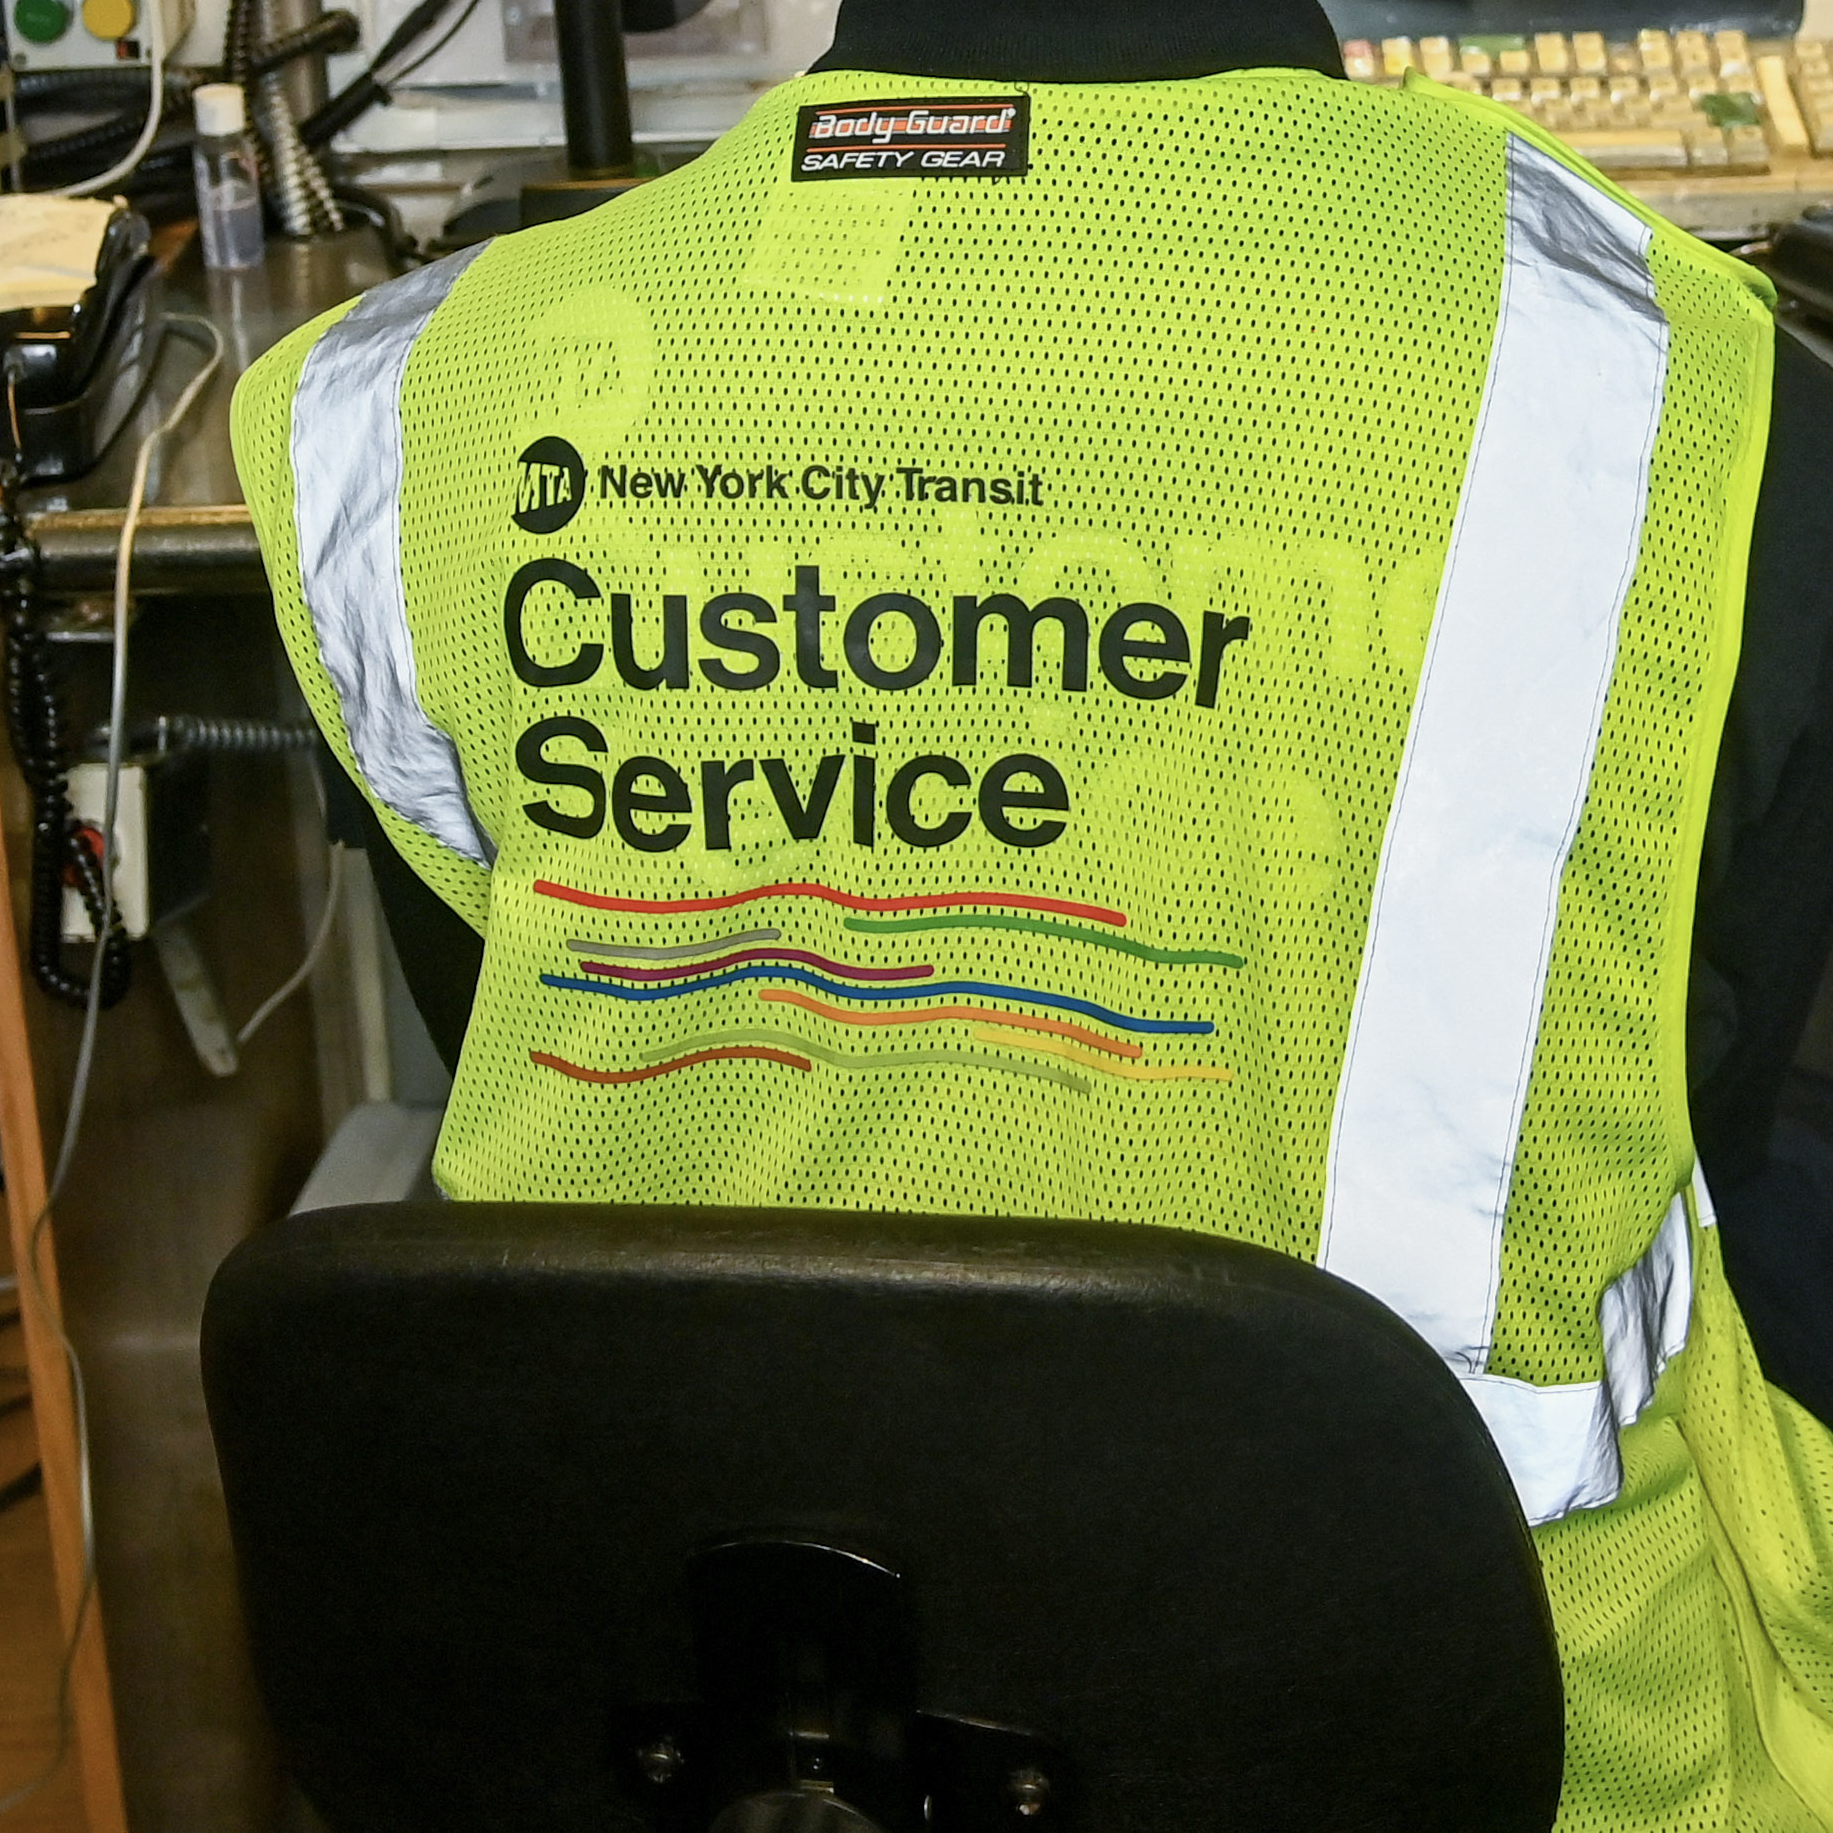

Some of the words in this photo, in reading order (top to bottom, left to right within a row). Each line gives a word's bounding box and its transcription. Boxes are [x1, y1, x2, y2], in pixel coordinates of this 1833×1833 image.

[813, 111, 895, 144] Body
[905, 109, 1012, 135] Guard
[800, 150, 915, 172] SAFETY
[920, 149, 1007, 169] GEAR
[599, 464, 685, 500] New
[694, 464, 790, 500] York
[801, 465, 886, 510] City
[896, 466, 1044, 507] Transit
[503, 557, 1250, 709] Customer
[515, 714, 1070, 853] Service
